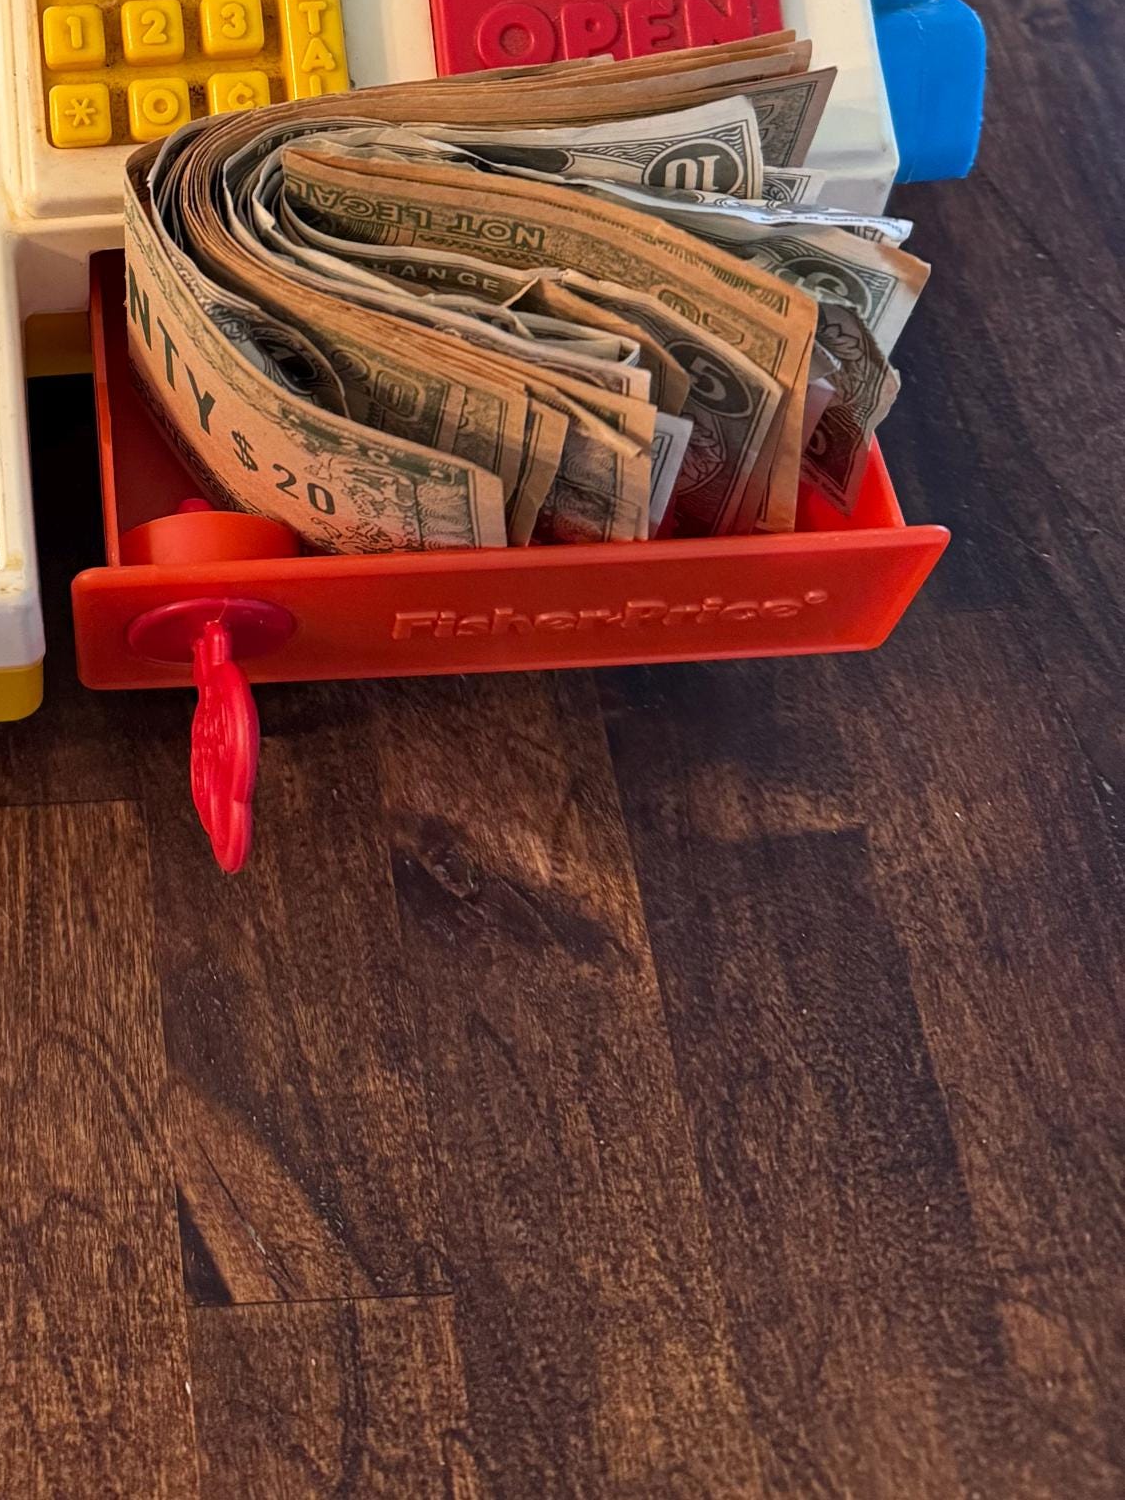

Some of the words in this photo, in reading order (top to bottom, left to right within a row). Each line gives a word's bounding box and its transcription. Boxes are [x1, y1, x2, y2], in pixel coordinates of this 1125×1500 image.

[66, 15, 84, 50] 1
[140, 10, 167, 44] 2
[220, 2, 247, 38] 3
[445, 211, 548, 251] NOT
